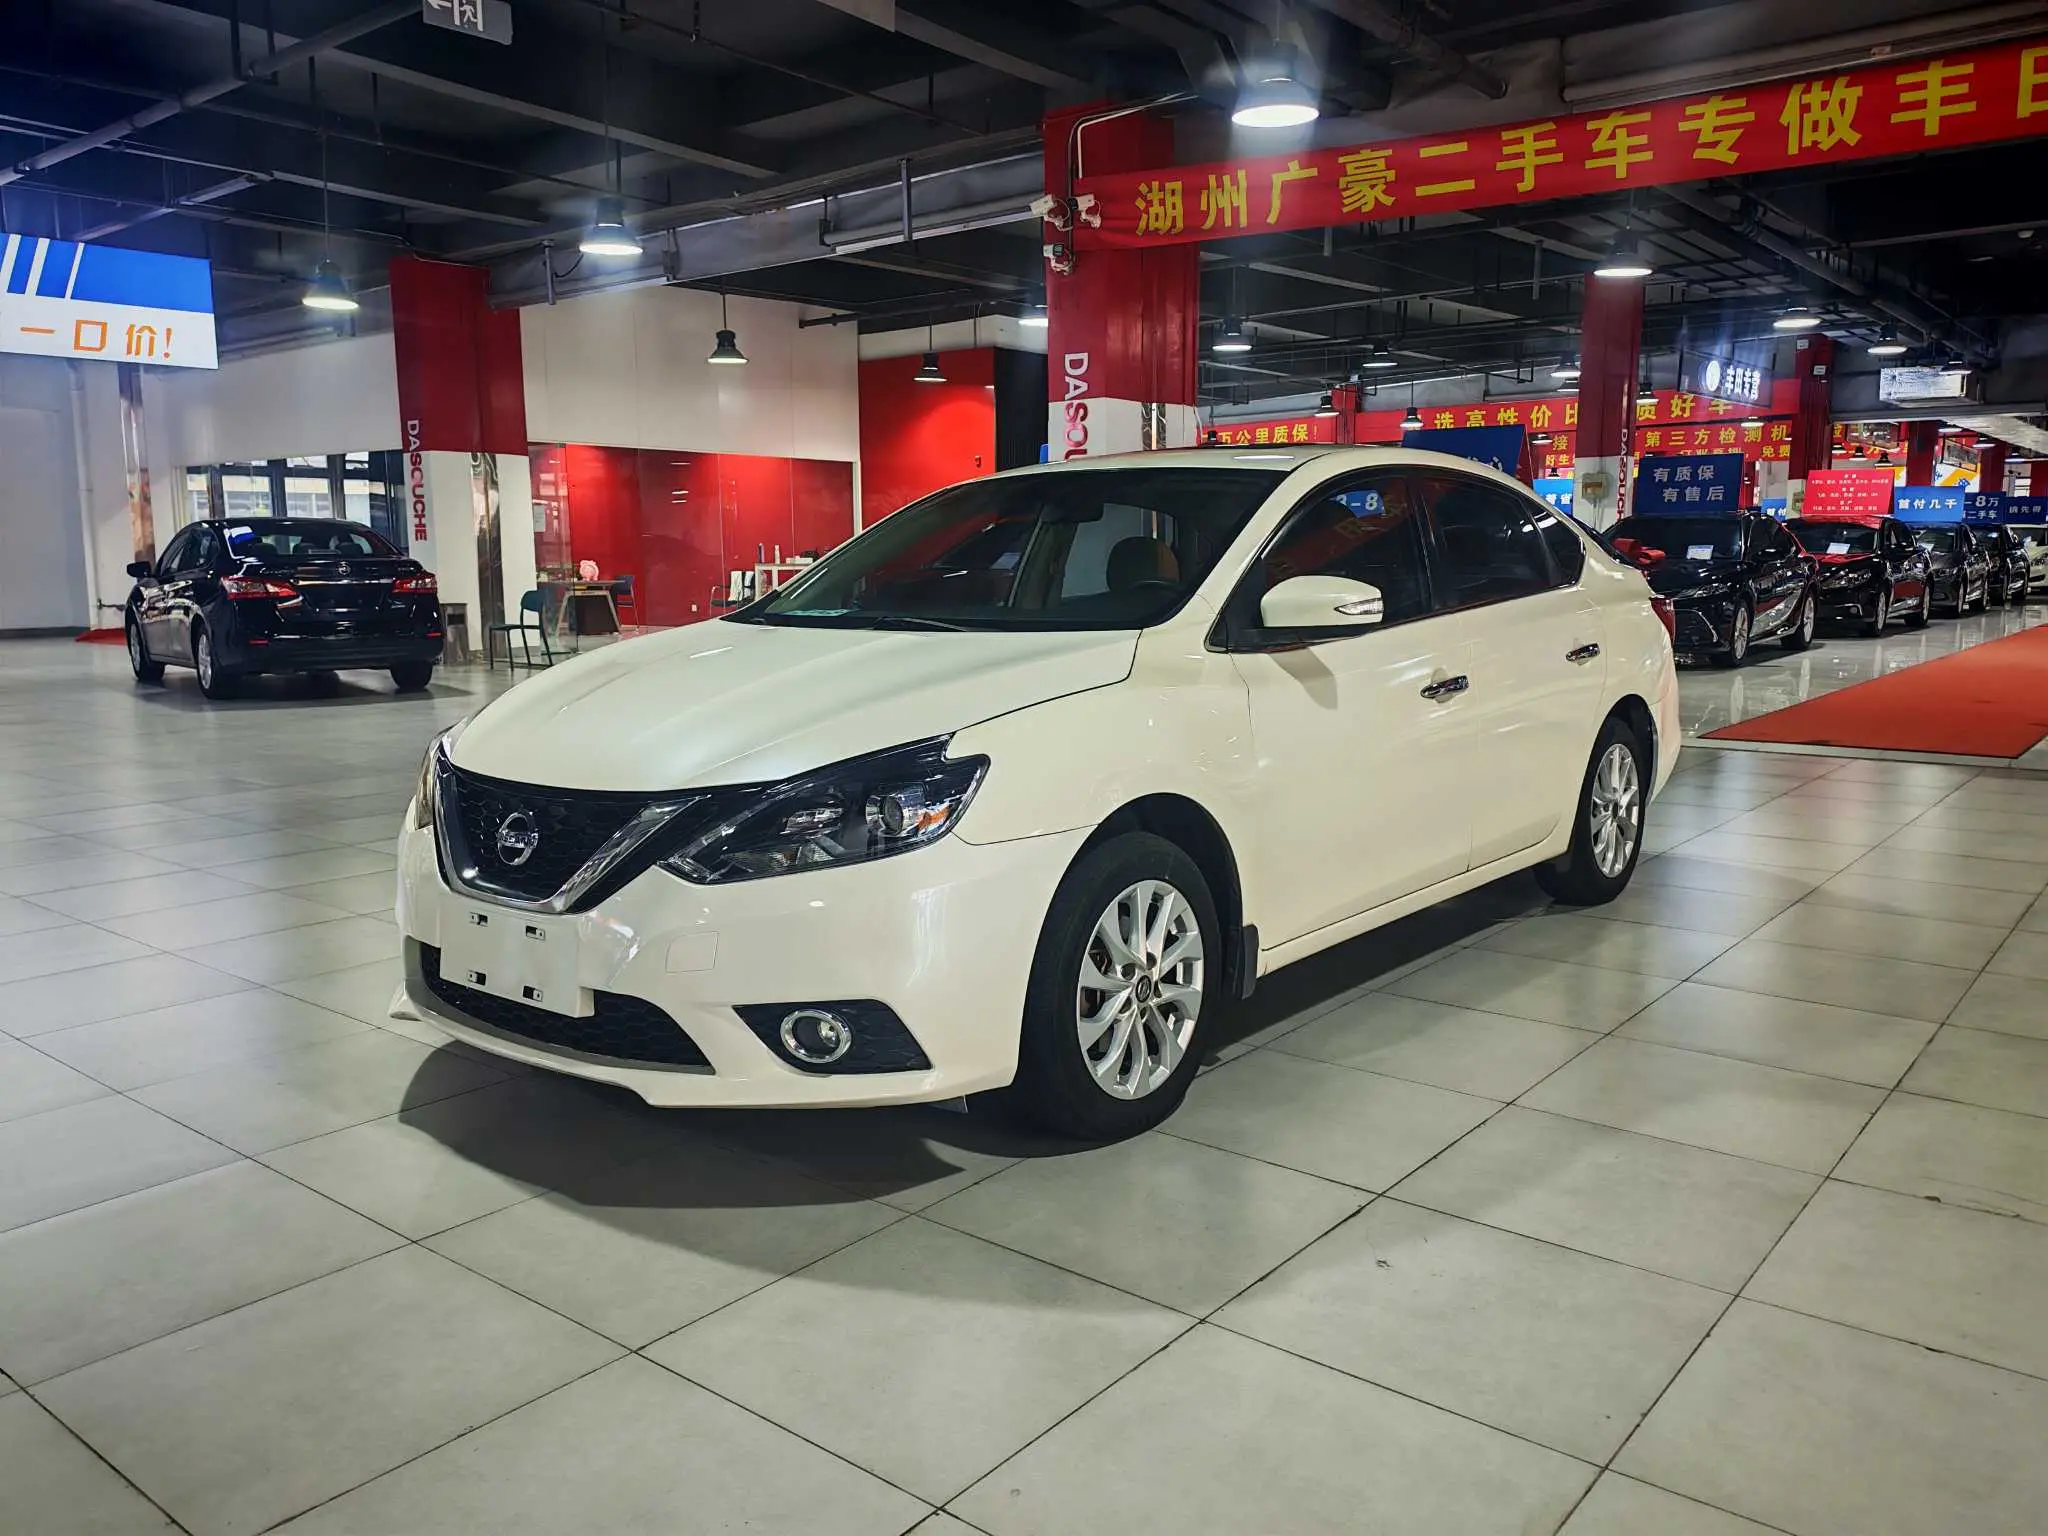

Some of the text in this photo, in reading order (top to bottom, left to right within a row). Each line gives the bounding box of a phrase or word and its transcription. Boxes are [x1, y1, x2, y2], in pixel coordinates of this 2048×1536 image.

[1202, 423, 1318, 444] 万公里质保!
[1653, 464, 1715, 484] 有质保
[1662, 485, 1725, 503] 有售后
